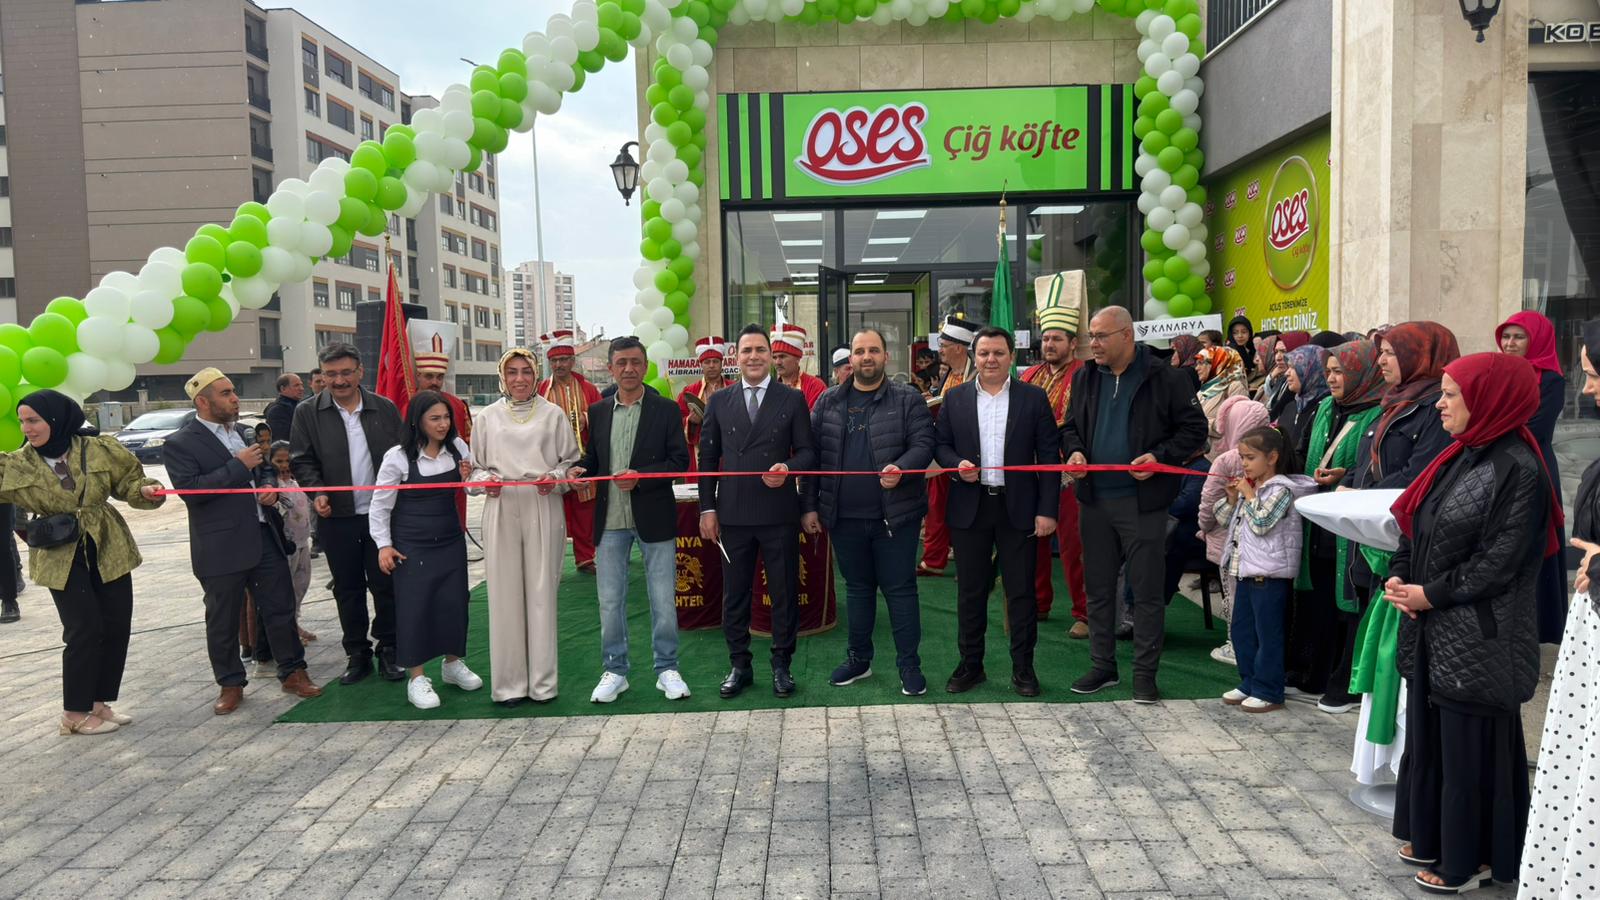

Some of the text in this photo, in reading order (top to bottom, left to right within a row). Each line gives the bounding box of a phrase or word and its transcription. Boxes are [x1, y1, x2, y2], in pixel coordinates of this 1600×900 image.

[943, 120, 1080, 161] Çiğ köfte
[1151, 320, 1205, 333] KANARYA
[676, 536, 703, 548] NYA
[675, 595, 704, 608] HTER
